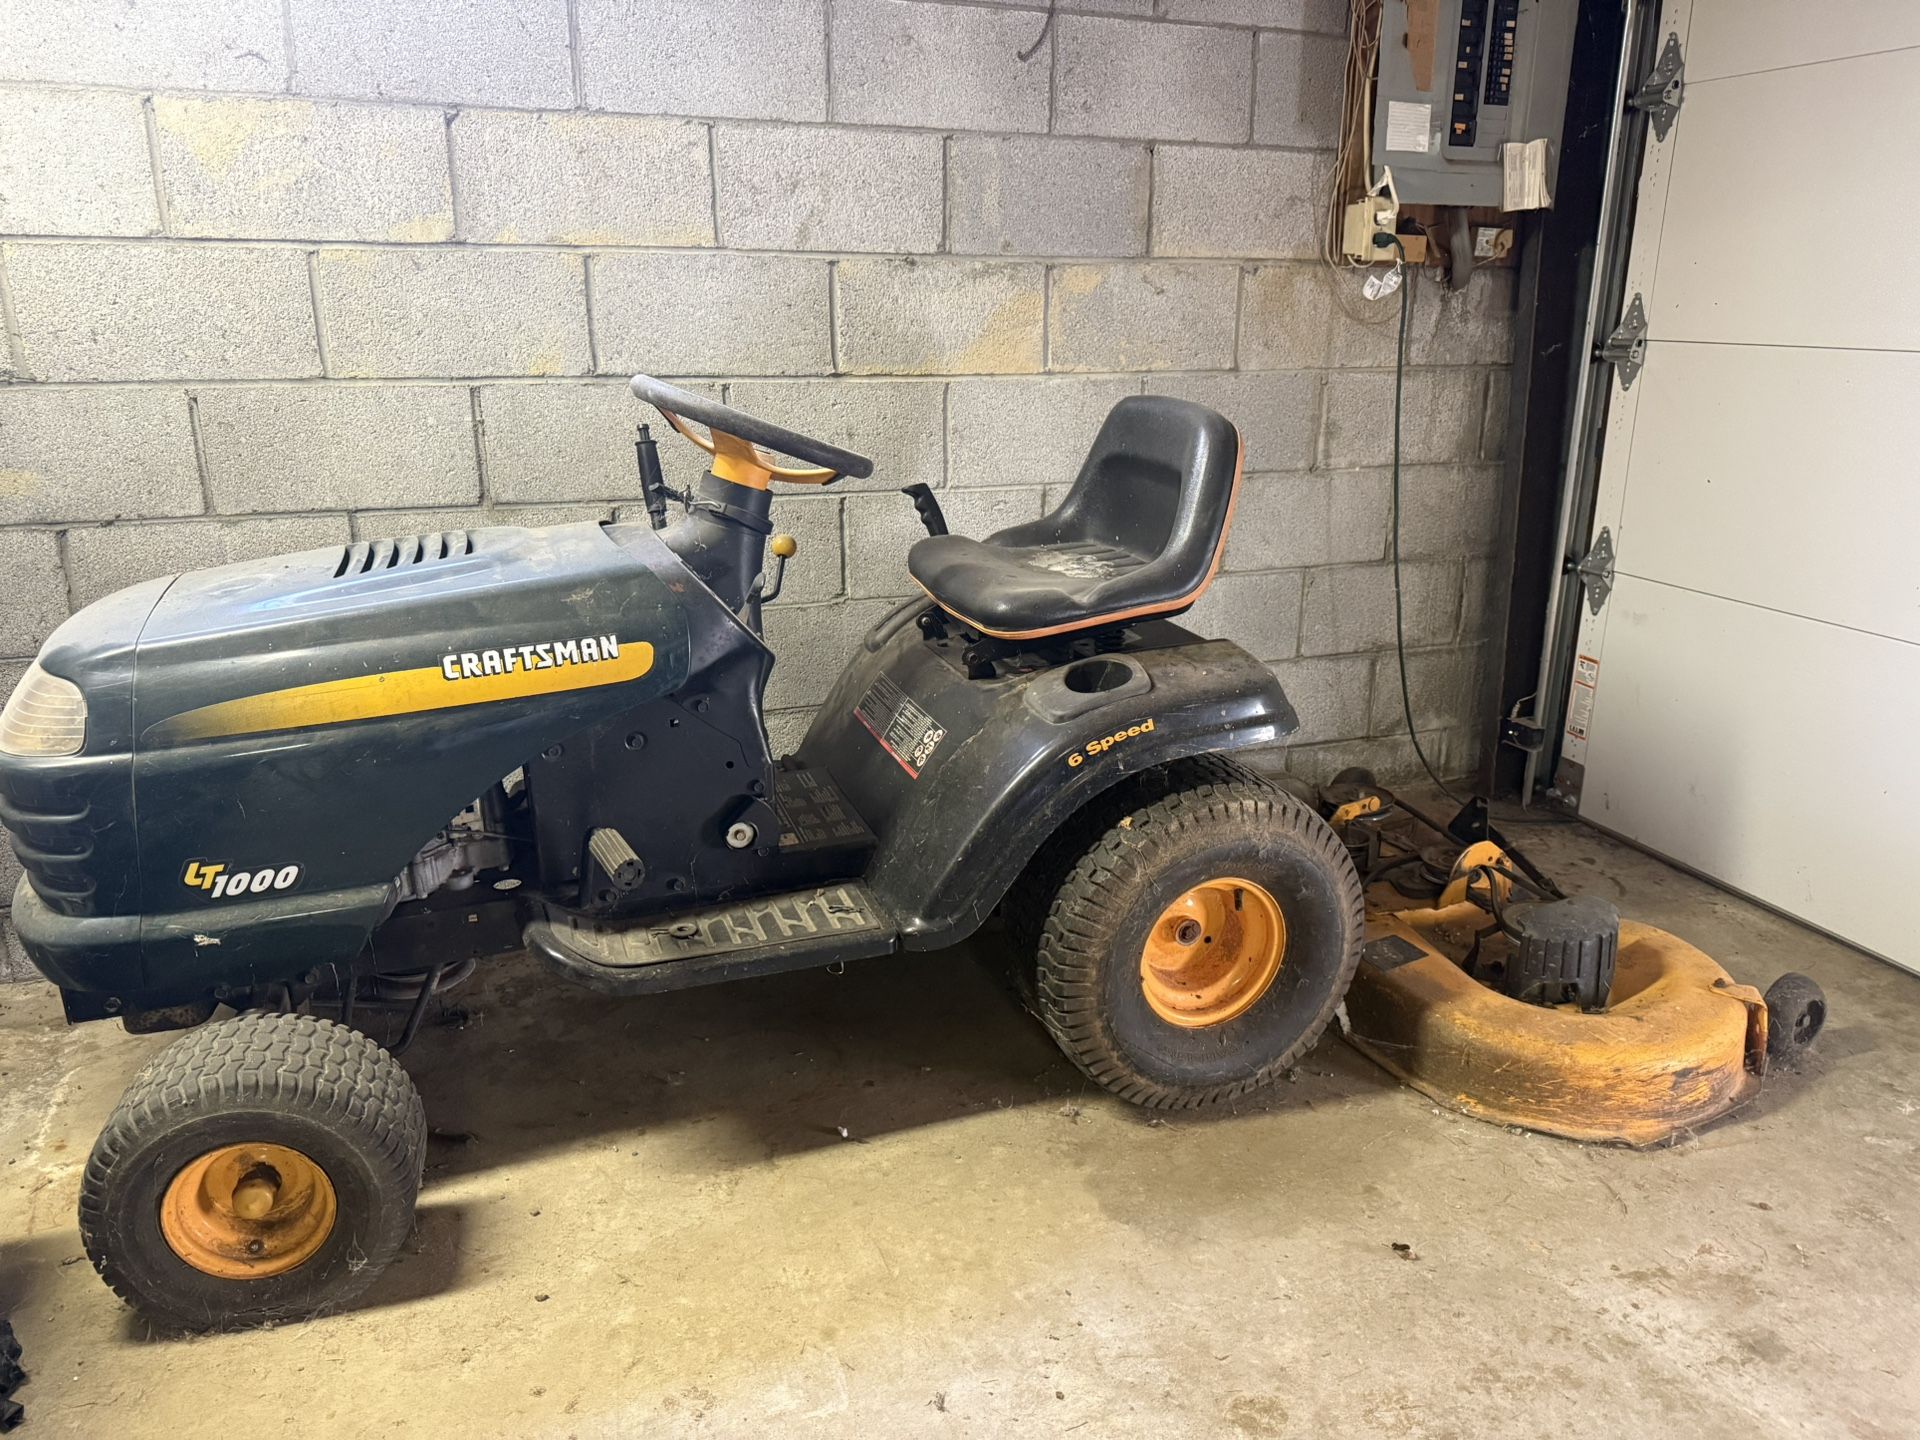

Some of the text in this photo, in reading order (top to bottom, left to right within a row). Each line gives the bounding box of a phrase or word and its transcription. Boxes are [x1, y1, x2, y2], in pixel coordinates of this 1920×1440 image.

[442, 634, 620, 681] CRAFTSMAN
[1067, 718, 1155, 767] 6 Speed
